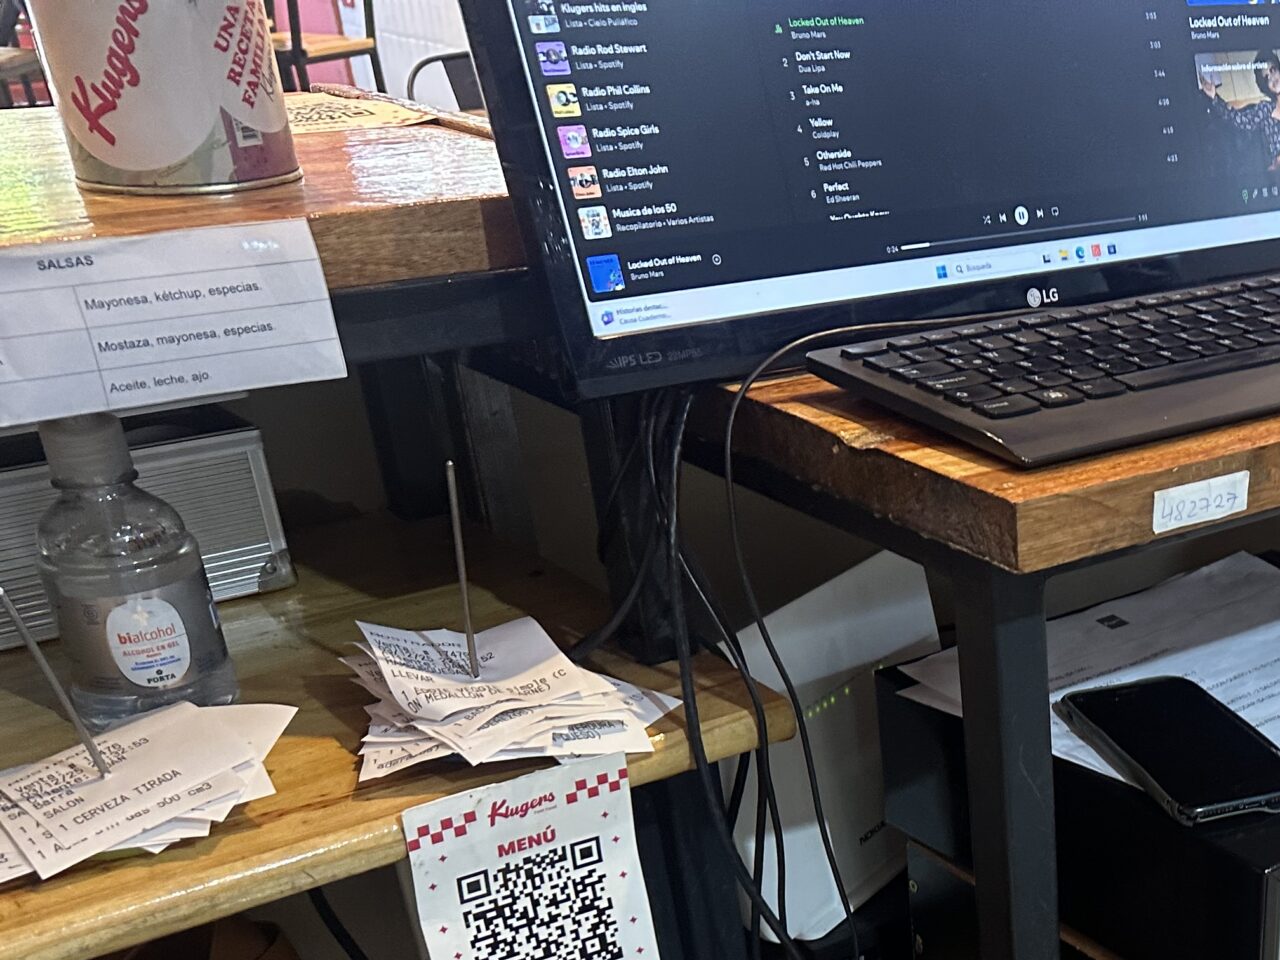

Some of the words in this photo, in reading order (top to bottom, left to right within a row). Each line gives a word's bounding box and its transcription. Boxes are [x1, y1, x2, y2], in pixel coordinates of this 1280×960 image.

[560, 4, 594, 15] Klugers
[595, 3, 610, 13] hits
[611, 4, 622, 12] en
[788, 17, 814, 27] Locked
[815, 17, 829, 26] Out
[830, 17, 837, 25] of
[838, 16, 864, 25] Heaven
[1189, 16, 1217, 28] Locked
[1218, 17, 1233, 27] Out
[1233, 16, 1241, 26] of
[1241, 15, 1269, 26] Heaven
[214, 4, 240, 53] UNA
[1191, 32, 1208, 40] Bruno
[1208, 31, 1220, 39] Mars
[571, 45, 596, 55] Radio
[597, 45, 613, 54] Rod
[614, 44, 647, 53] Stewart
[795, 51, 815, 61] Don't
[816, 51, 833, 60] Start
[834, 50, 850, 59] Now
[576, 62, 593, 70] Lista
[599, 60, 624, 69] Spotify
[783, 58, 788, 67] 2
[798, 65, 811, 73] Dua
[812, 64, 825, 73] Lipa
[582, 87, 606, 97] Radio
[607, 86, 623, 96] Phil
[623, 85, 650, 94] Collins
[802, 85, 819, 95] Take
[820, 84, 831, 93] On
[831, 83, 843, 93] Me
[790, 91, 795, 100] 3
[586, 103, 603, 111] Lista
[609, 101, 634, 110] Spotify
[809, 118, 833, 127] Yellow
[592, 128, 617, 138] Radio
[618, 127, 639, 137] Spice
[640, 125, 659, 135] Girls
[797, 125, 803, 133] 4
[812, 131, 839, 139] Coldplay
[596, 143, 613, 152] Lista
[618, 141, 643, 151] Spotify
[816, 149, 851, 160] Otherside
[804, 158, 809, 166] 5
[819, 163, 832, 171] Red
[857, 159, 882, 169] Peppers
[602, 168, 626, 178] Radio
[627, 167, 648, 177] Elton
[649, 166, 669, 176] John
[606, 184, 623, 192] Lista
[628, 181, 653, 191] Spotify
[823, 183, 849, 192] Perfect
[811, 190, 816, 198] 6
[826, 196, 835, 204] Ed
[835, 194, 859, 203] Sheeran
[642, 207, 652, 216] de
[653, 206, 664, 214] los
[665, 203, 677, 213] 50
[616, 219, 662, 232] Recopilatorio
[666, 217, 687, 226] Varios
[688, 215, 713, 224] Artistas
[37, 255, 94, 271] SALSAS
[628, 259, 653, 270] Locked
[654, 257, 668, 267] Out
[668, 256, 675, 265] of
[676, 254, 701, 264] Heaven
[631, 272, 649, 280] Bruno
[649, 270, 664, 278] Mars
[84, 291, 153, 311] Mayonesa,
[154, 285, 207, 305] kétchup,
[208, 281, 262, 299] especias.
[1043, 288, 1059, 303] LG
[98, 335, 155, 353] Mostaza,
[156, 327, 221, 346] mayonesa,
[223, 321, 276, 339] especias.
[110, 380, 151, 394] Aceite,
[153, 372, 189, 388] leche,
[117, 623, 176, 645] bialcohol
[122, 648, 155, 657] ALCOHOL
[167, 641, 180, 649] GEL
[146, 673, 177, 684] PORTA
[391, 668, 434, 683] LLEVAR
[406, 701, 423, 714] ON
[188, 782, 213, 797] cm3
[59, 823, 69, 832] 1
[72, 794, 131, 825] CERVEZA
[133, 769, 182, 796] TIRADA
[43, 795, 86, 820] SALON
[487, 792, 556, 828] Klugers
[859, 819, 886, 847] NOKIA
[497, 824, 557, 858] MENÚ
